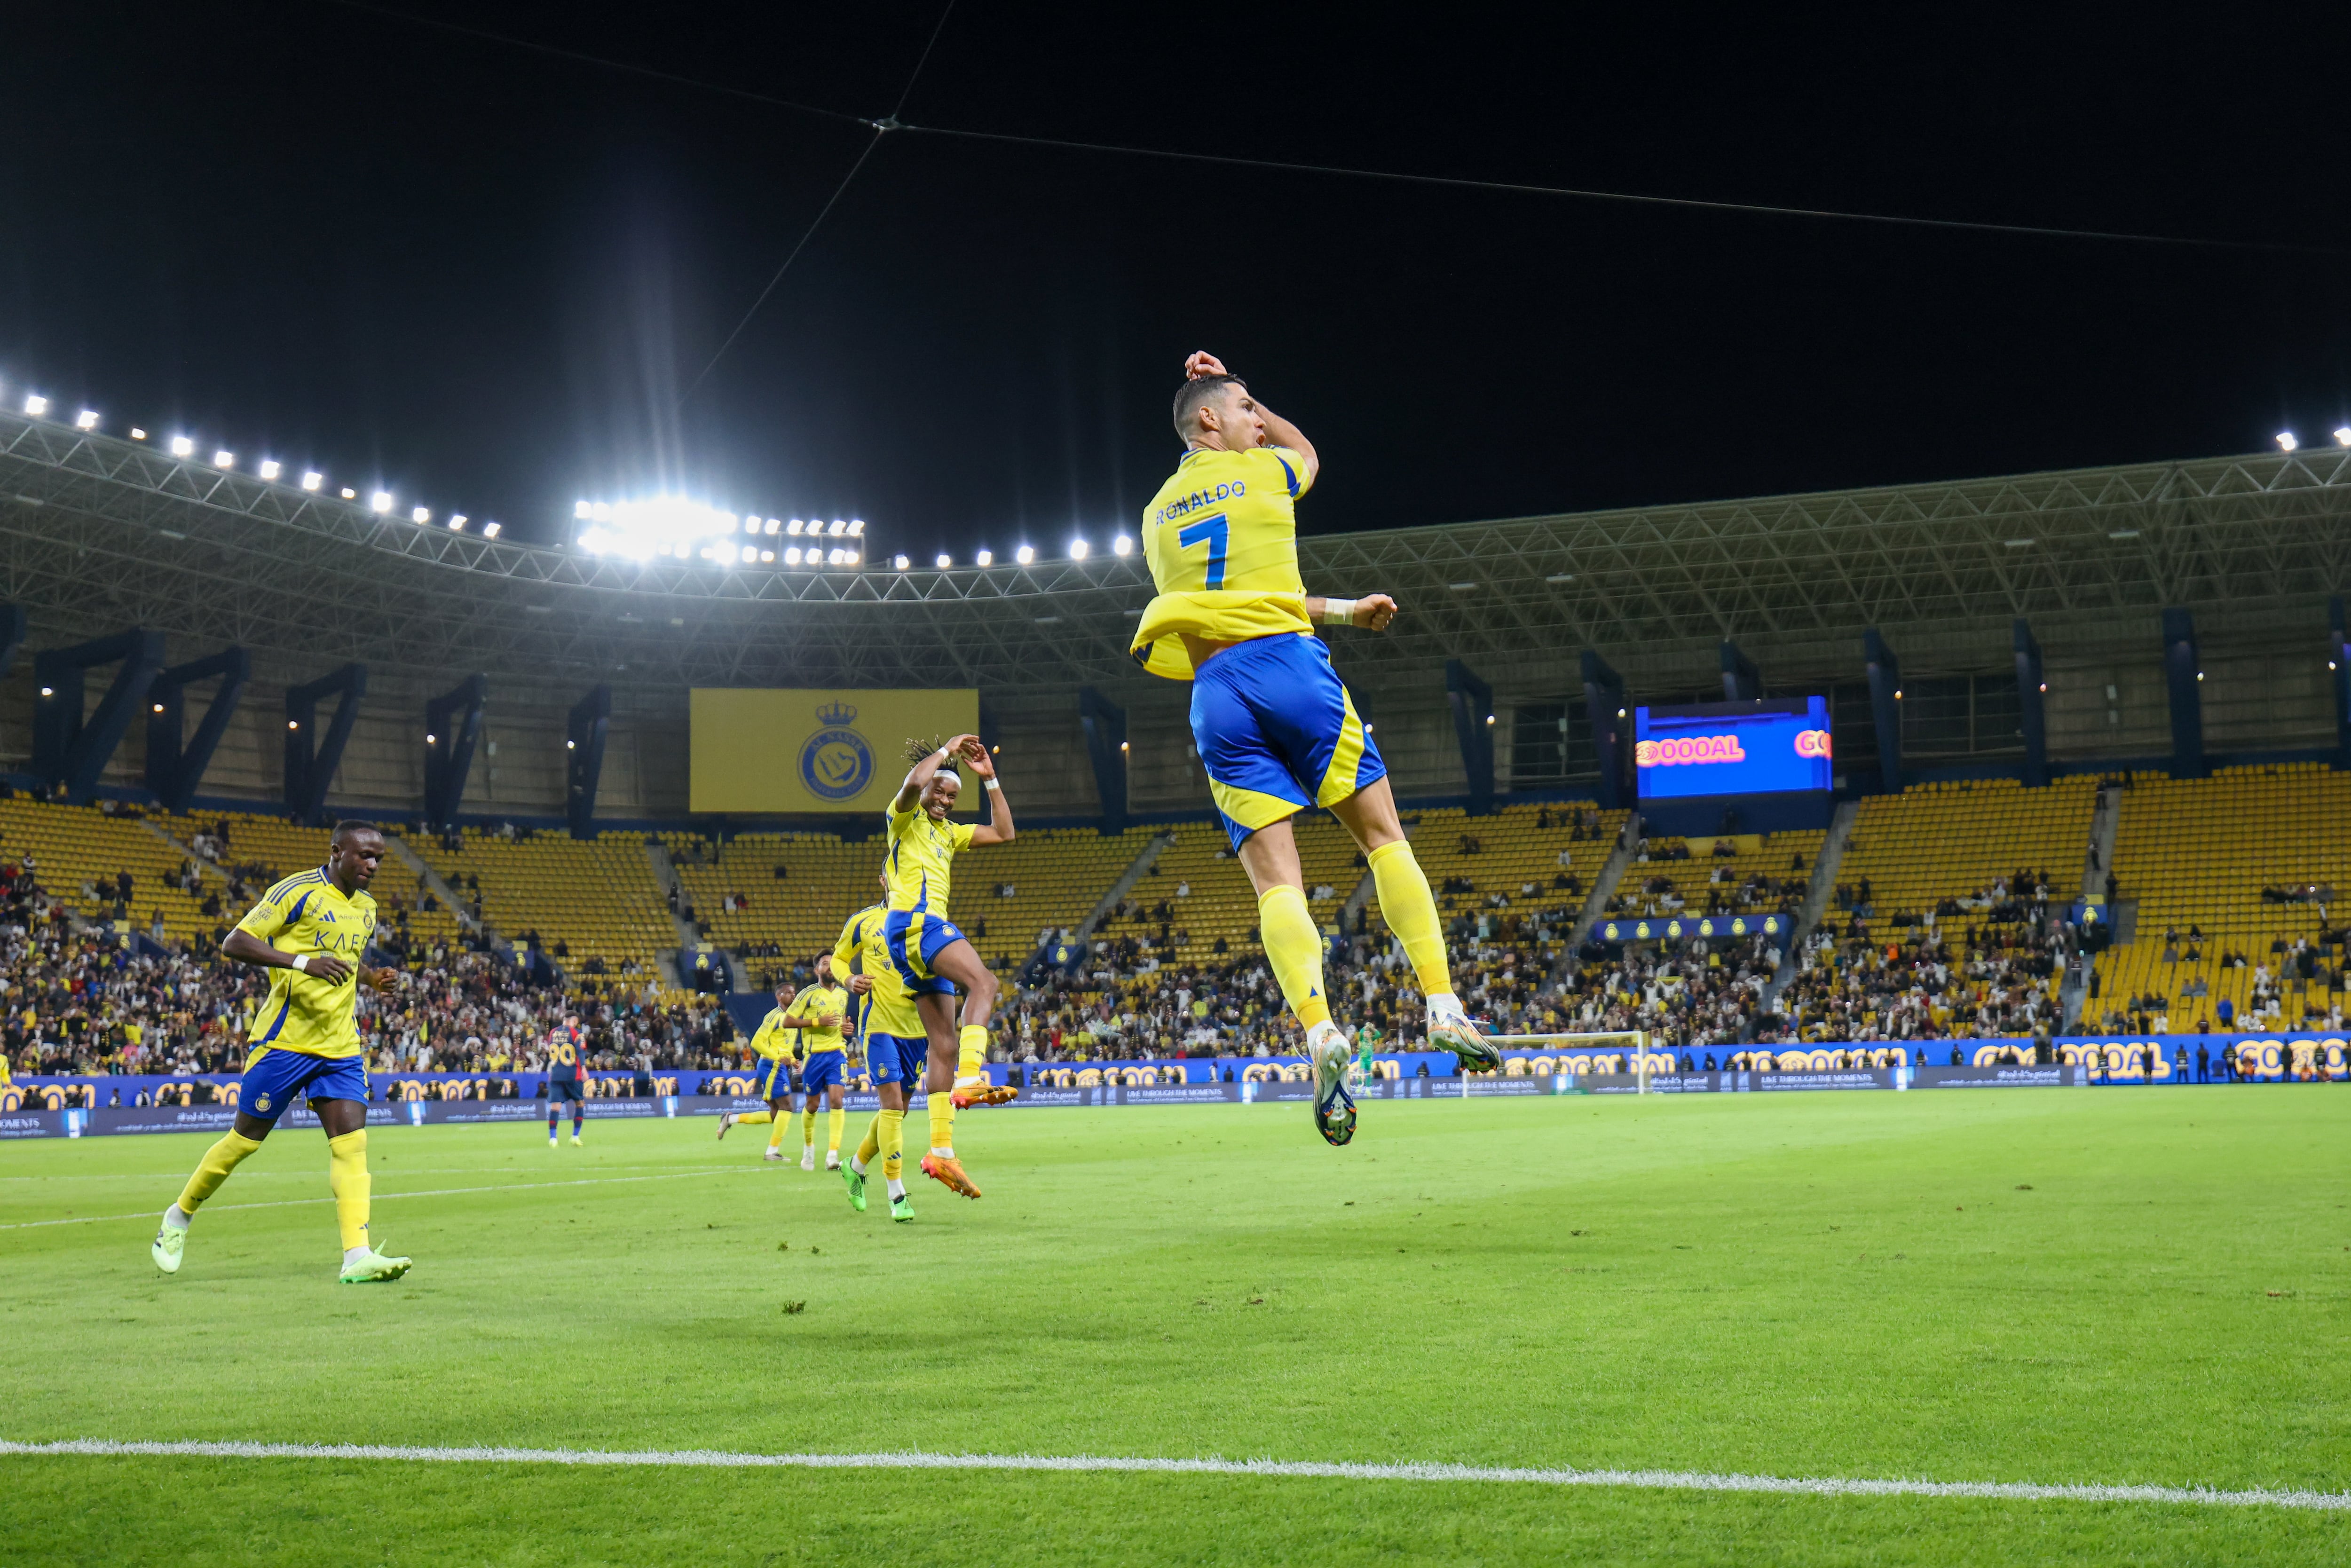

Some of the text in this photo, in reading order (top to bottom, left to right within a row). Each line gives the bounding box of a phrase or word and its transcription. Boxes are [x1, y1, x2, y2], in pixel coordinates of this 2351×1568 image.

[1156, 480, 1246, 527] RONALDO
[1177, 512, 1230, 591] 7
[549, 1043, 576, 1067] 90
